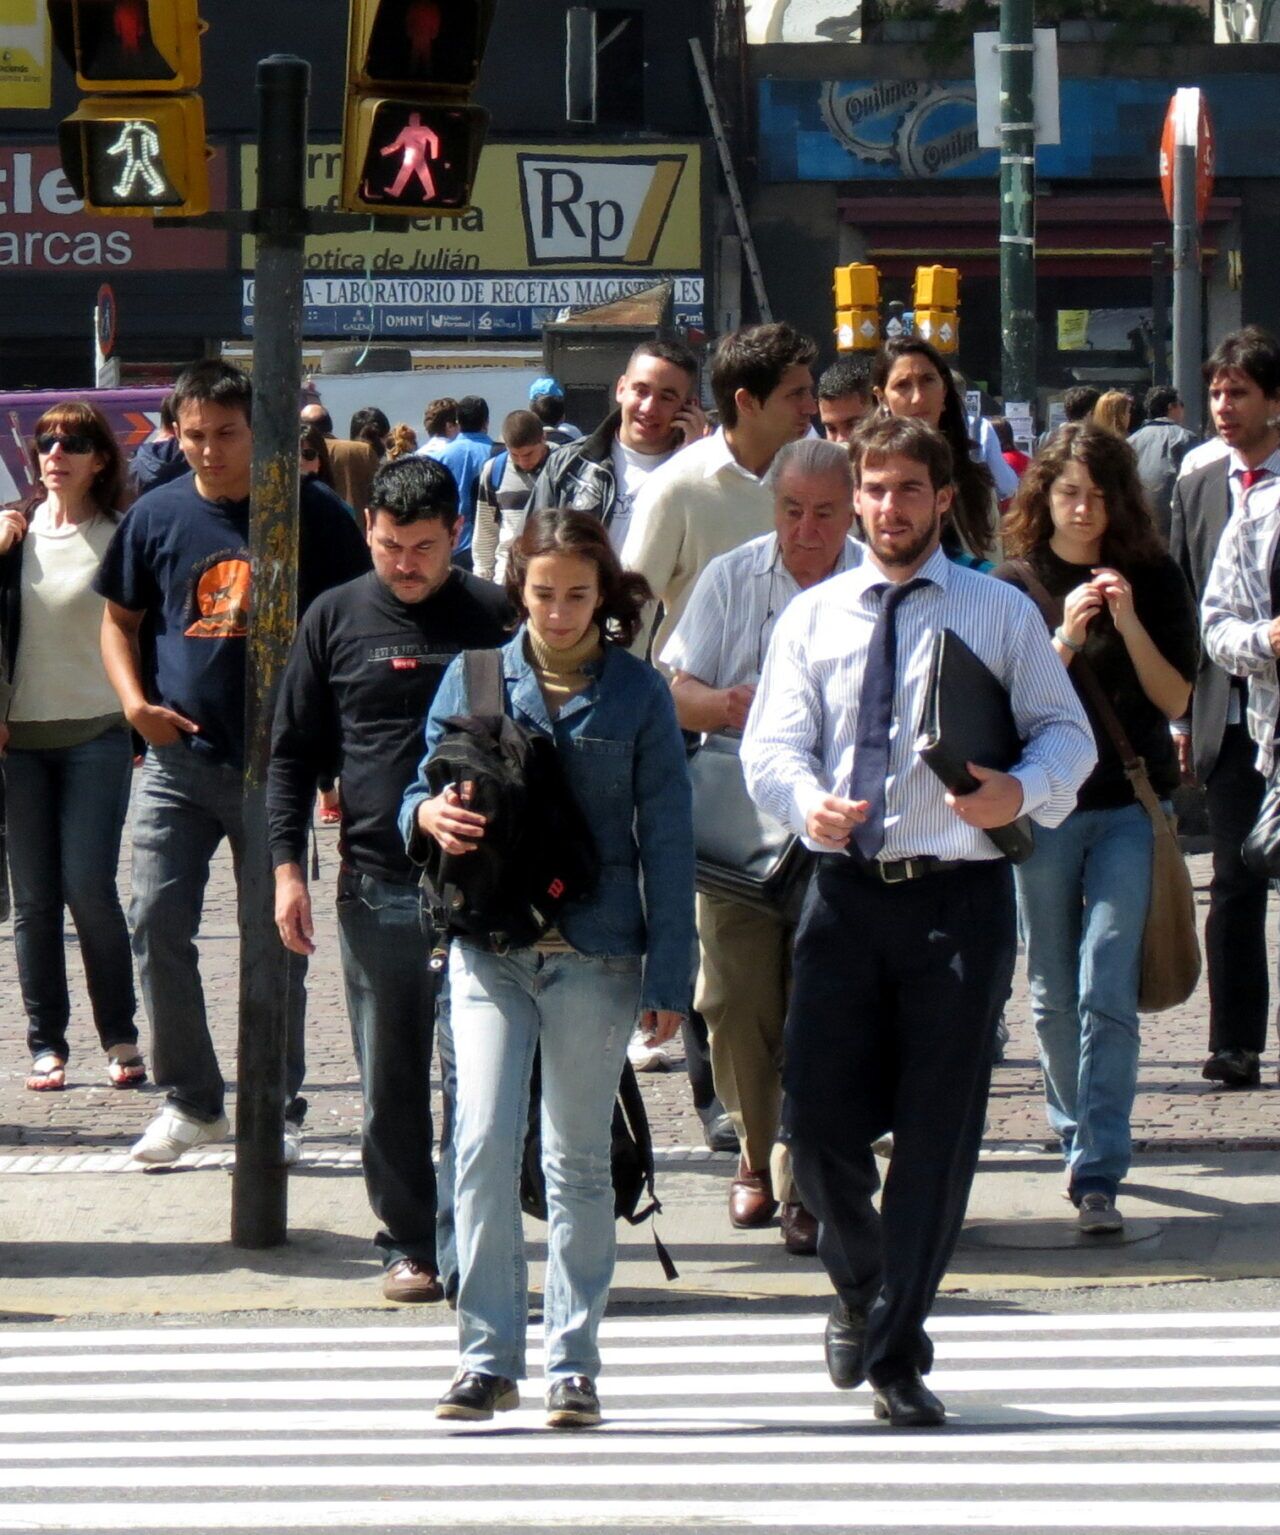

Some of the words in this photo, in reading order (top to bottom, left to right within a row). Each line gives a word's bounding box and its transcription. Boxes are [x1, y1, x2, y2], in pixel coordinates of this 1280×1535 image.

[533, 168, 624, 258] Rp
[304, 249, 365, 270] otica
[373, 248, 404, 270] de
[408, 248, 480, 271] Julián
[325, 281, 456, 304] LABORATORIO
[462, 281, 485, 304] DE
[490, 280, 569, 304] RECETAS
[385, 314, 424, 328] OMINT
